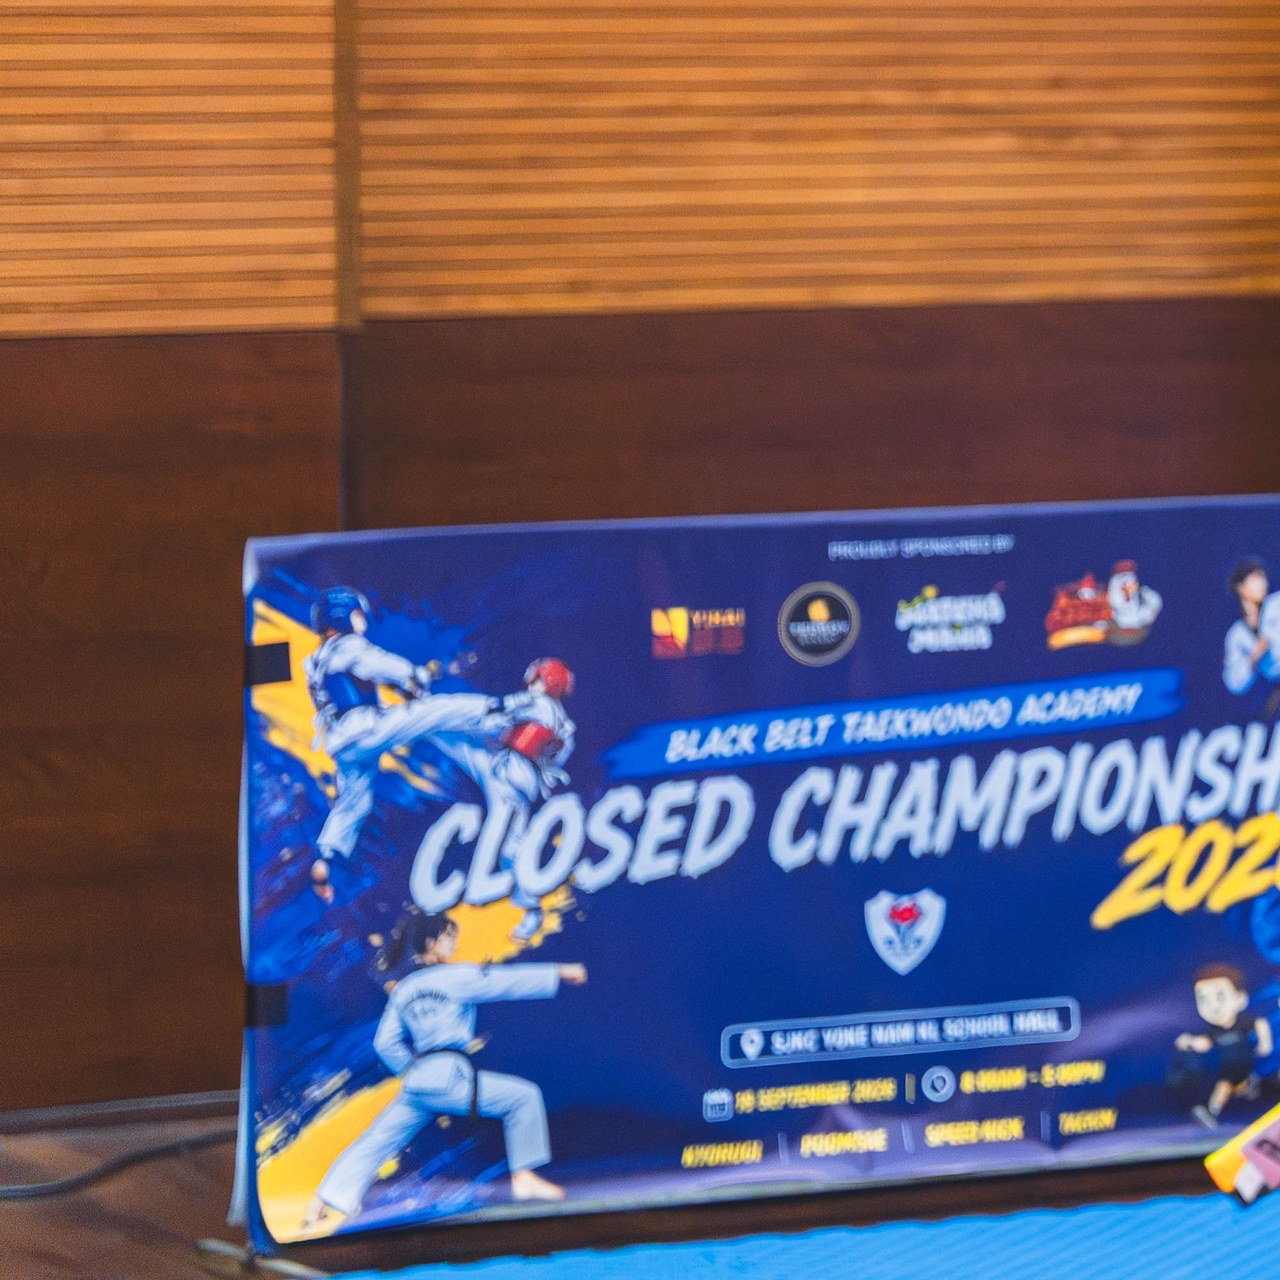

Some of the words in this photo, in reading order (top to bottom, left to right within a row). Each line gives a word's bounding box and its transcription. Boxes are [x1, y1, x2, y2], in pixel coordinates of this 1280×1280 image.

[665, 722, 758, 763] BLACK
[763, 713, 835, 753] BELT
[842, 696, 1013, 744] TAEKWONDO
[1016, 682, 1144, 727] ACADEMY
[409, 774, 756, 915] CLOSED
